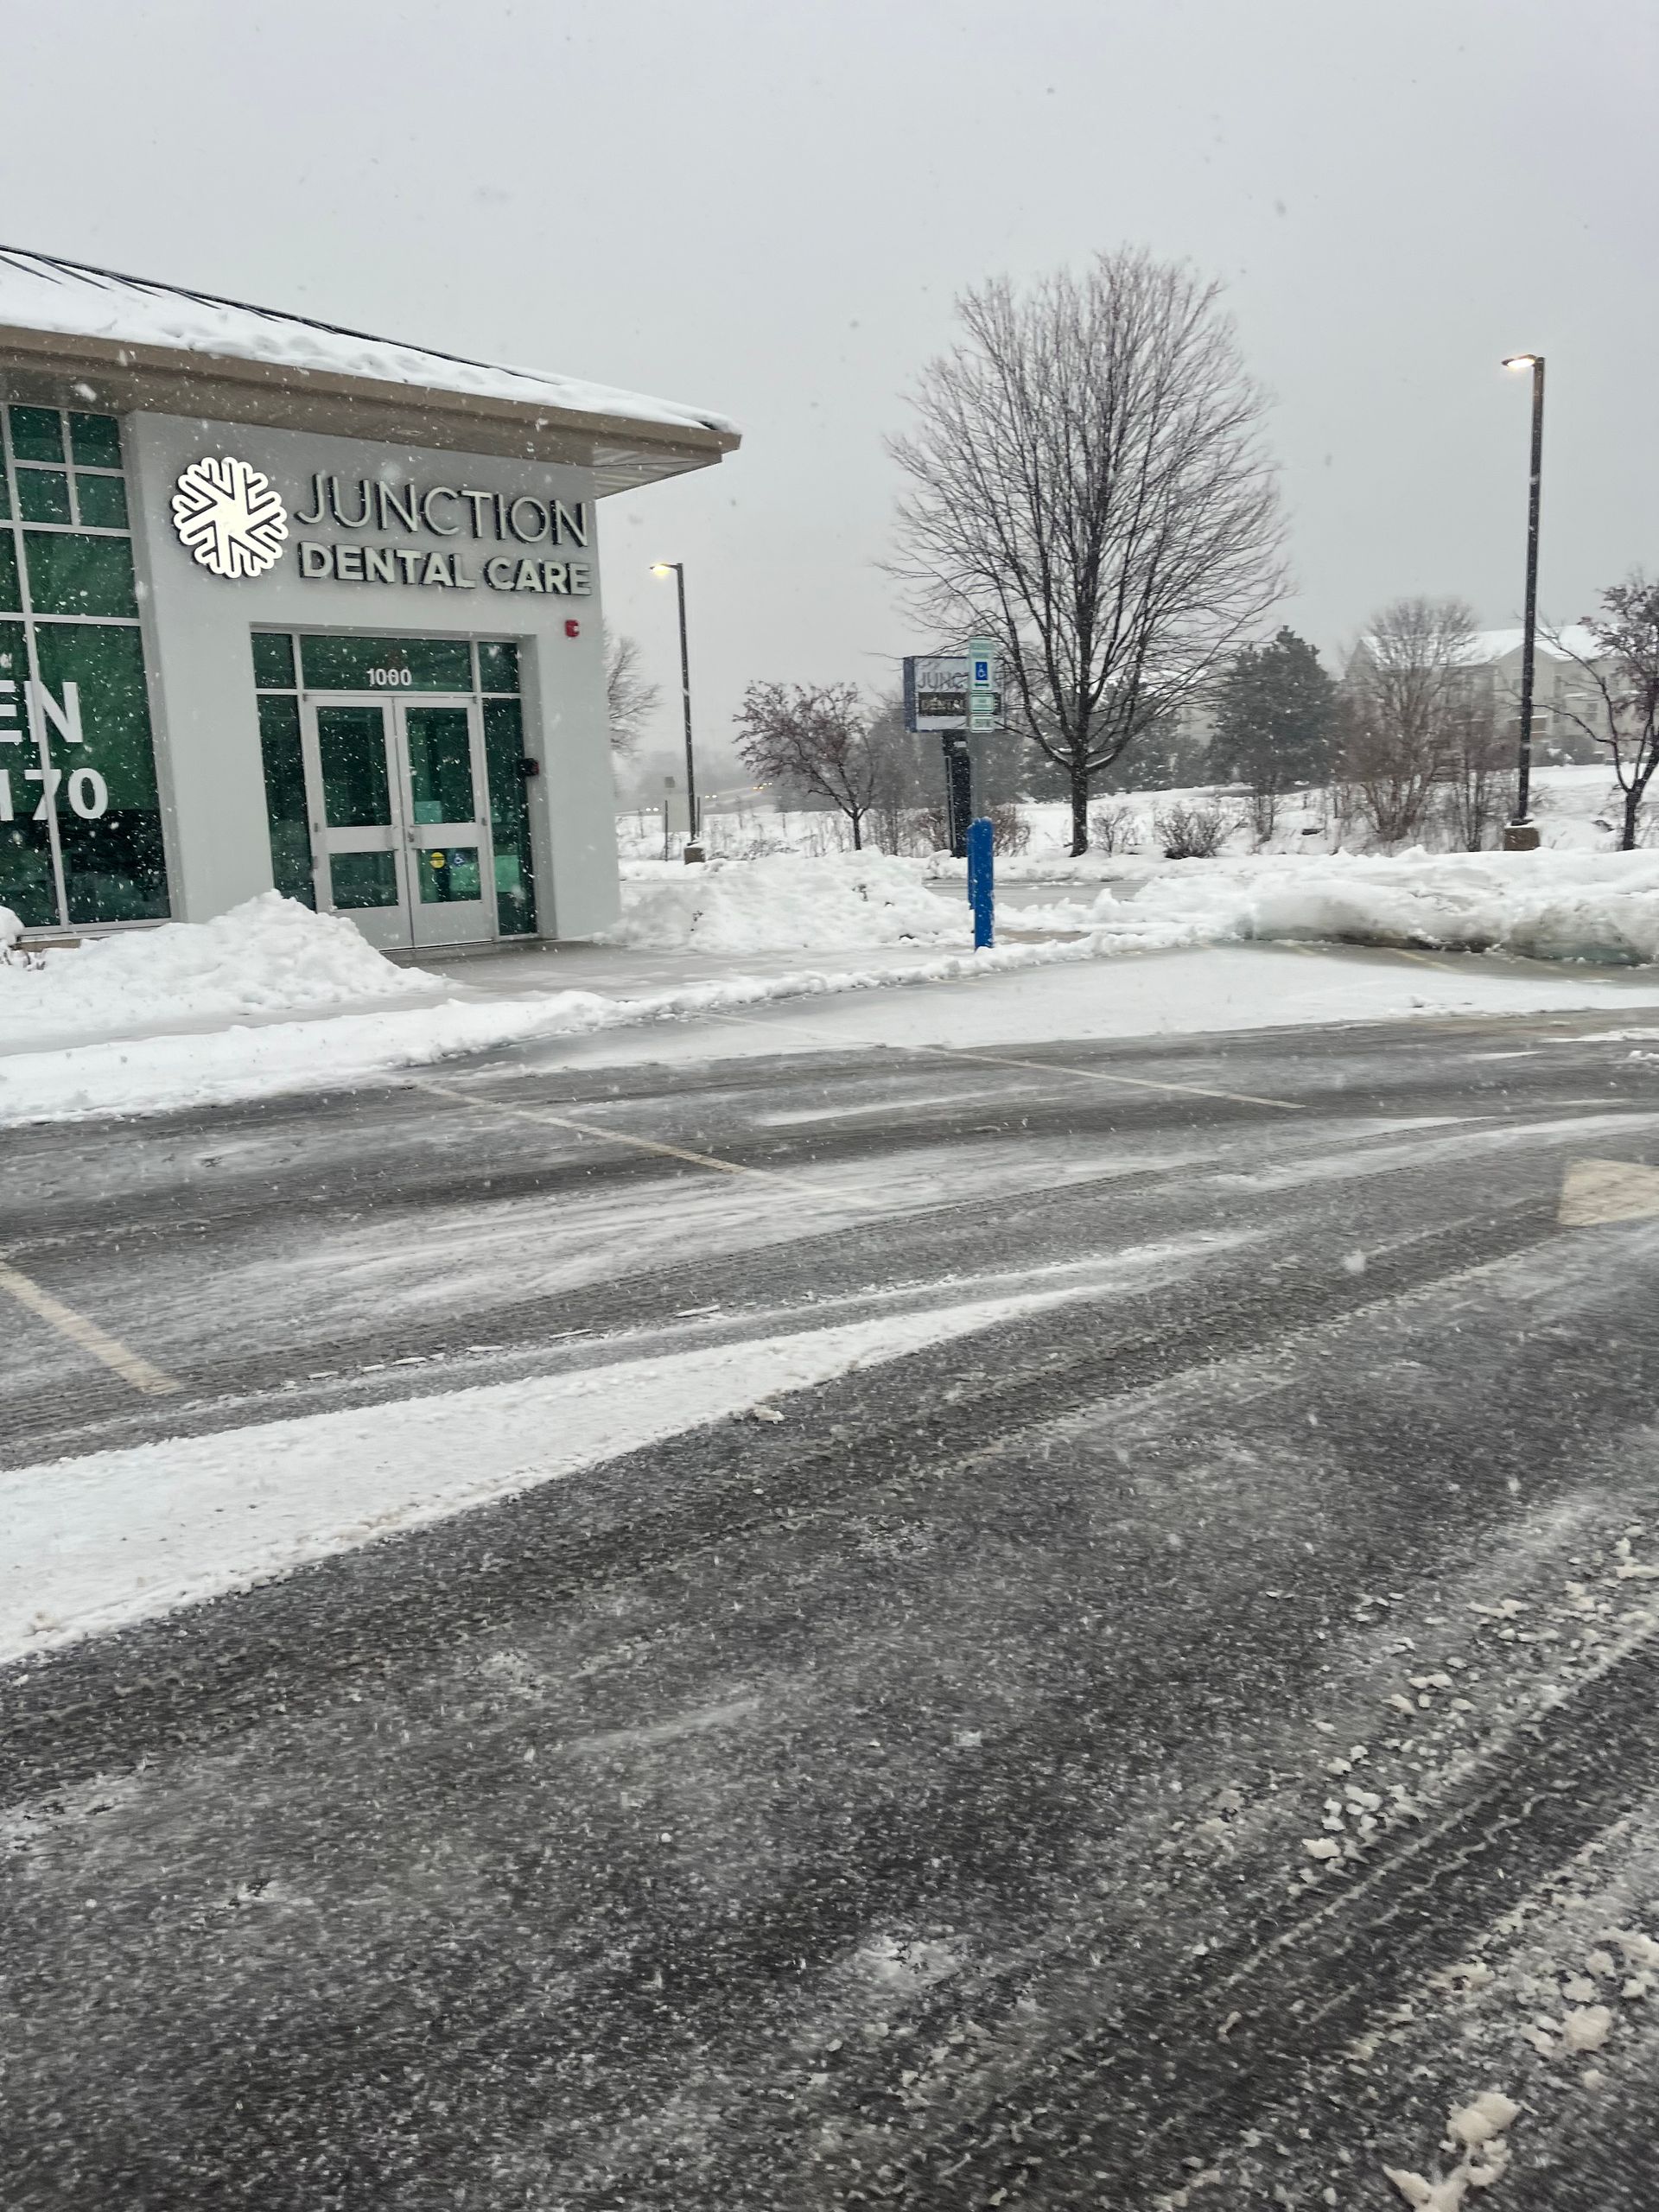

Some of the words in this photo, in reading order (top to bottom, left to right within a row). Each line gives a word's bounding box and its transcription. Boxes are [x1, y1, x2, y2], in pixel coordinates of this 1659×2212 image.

[294, 474, 588, 547] JUNCTION
[298, 541, 476, 588] DENTAL
[484, 556, 592, 595] CARE
